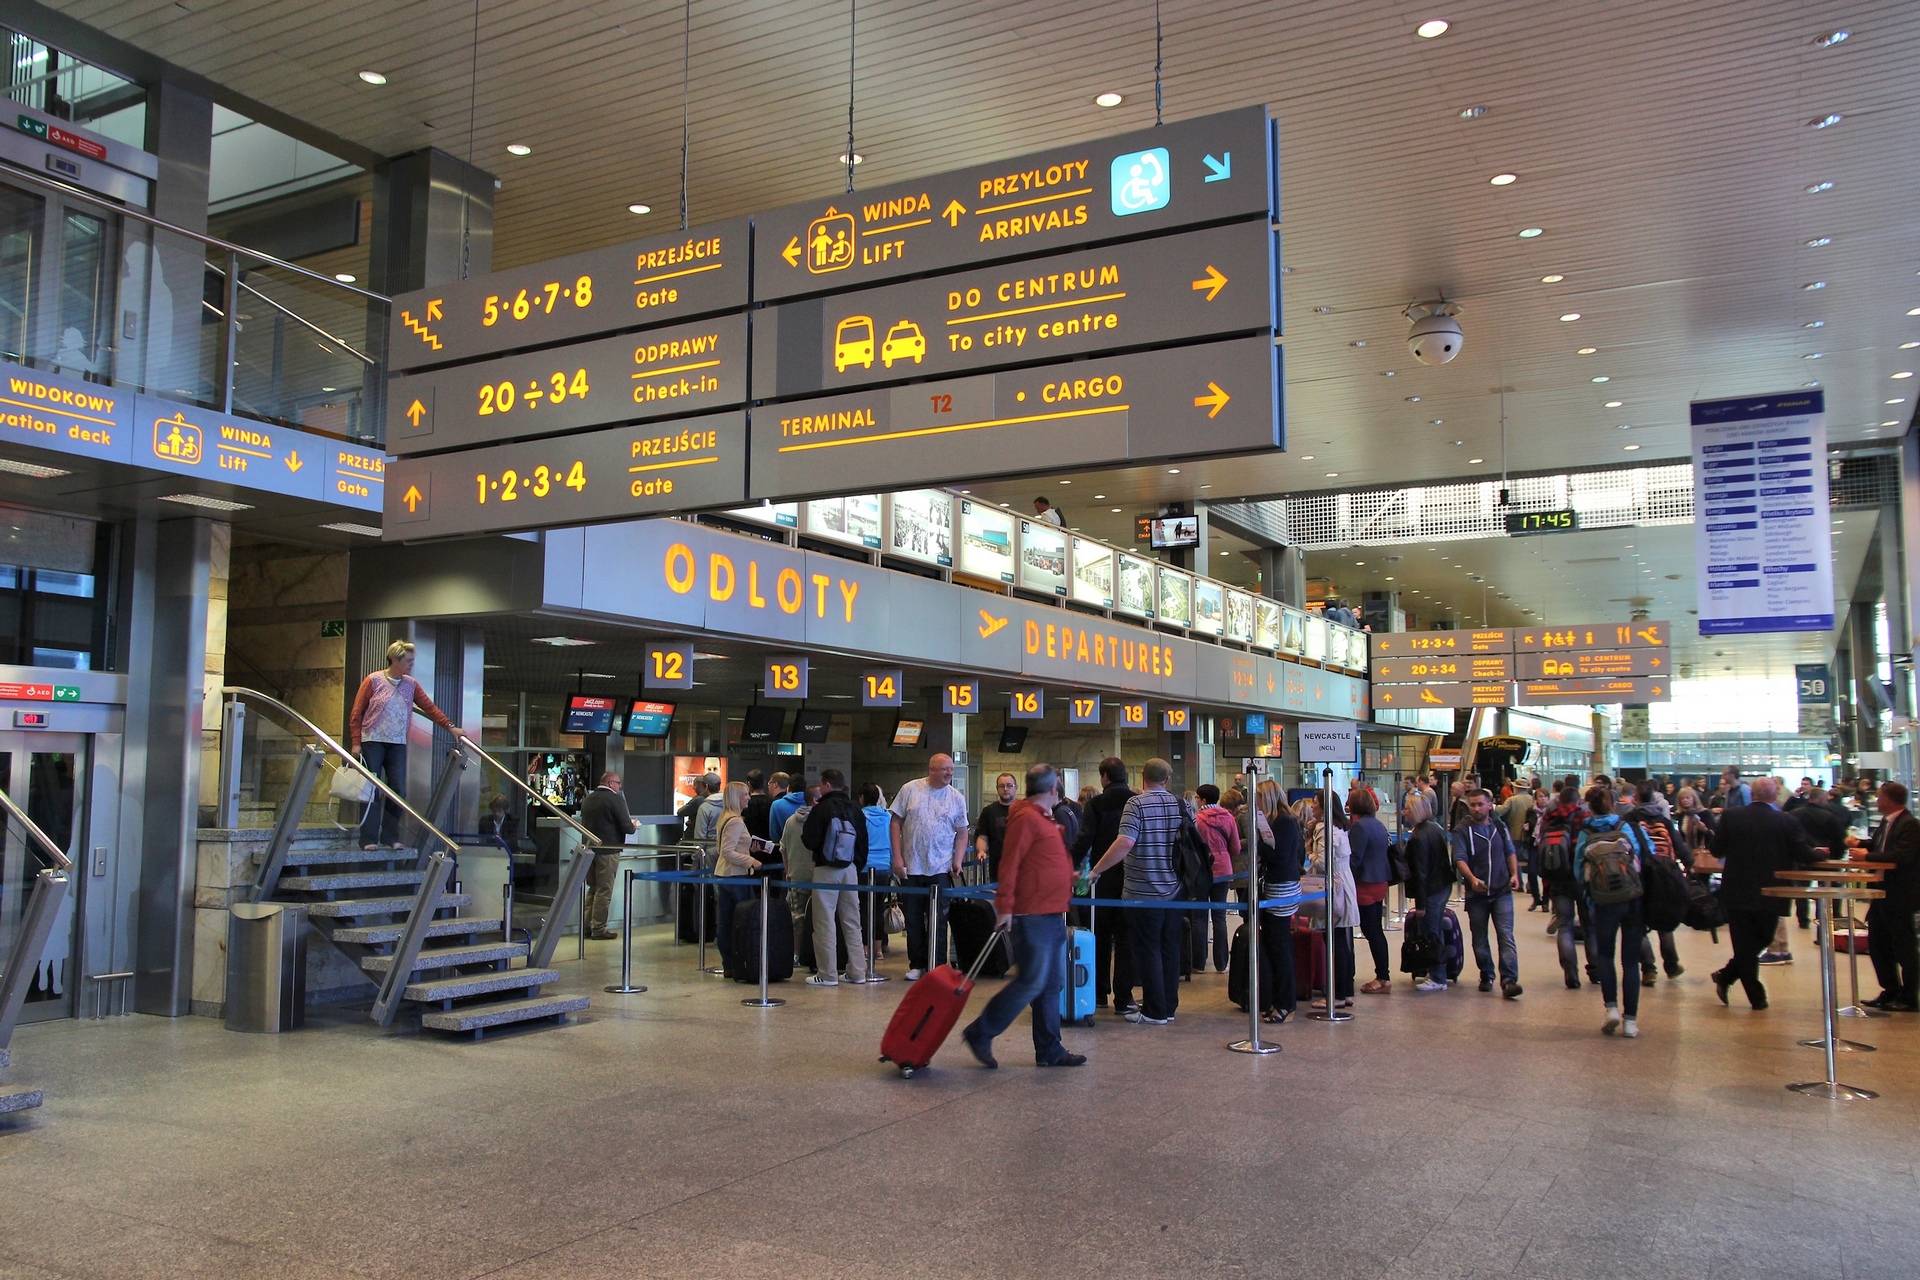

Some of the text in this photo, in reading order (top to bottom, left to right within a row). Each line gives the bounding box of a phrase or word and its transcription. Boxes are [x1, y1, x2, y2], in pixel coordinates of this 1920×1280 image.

[979, 159, 1090, 200] PRZYLOTY
[863, 193, 931, 222] WINDA
[979, 205, 1088, 244] ARRIVALS
[636, 237, 722, 270] PRZEJŚCIE
[863, 239, 906, 265] LIFT
[636, 288, 678, 309] Gate
[948, 265, 1120, 311] DO CENTRUM
[949, 312, 1118, 353] To city centre
[634, 335, 718, 364] ODPRAWY
[10, 377, 116, 414] WIDOKOWY
[634, 376, 718, 404] Check-in
[781, 375, 1124, 438] TERMINAL T2 CARGO
[68, 424, 112, 446] deck
[220, 425, 272, 448] WINDA
[631, 430, 716, 458] PRZEJŚCIE
[219, 454, 248, 472] Lift
[339, 452, 386, 473] PRZEJŚ
[338, 480, 368, 497] Gate
[630, 476, 673, 498] Gate
[1522, 512, 1571, 528] 17:45
[664, 543, 859, 624] ODLOTY
[1025, 619, 1174, 678] DEPARTURES
[651, 650, 682, 680] 12
[770, 664, 800, 691] 13
[866, 675, 896, 700] 14
[948, 684, 972, 708] 15
[1800, 679, 1825, 696] 50
[1015, 692, 1038, 714] 16
[1074, 699, 1094, 718] 17
[1125, 704, 1144, 722] 18
[1168, 710, 1186, 726] 19
